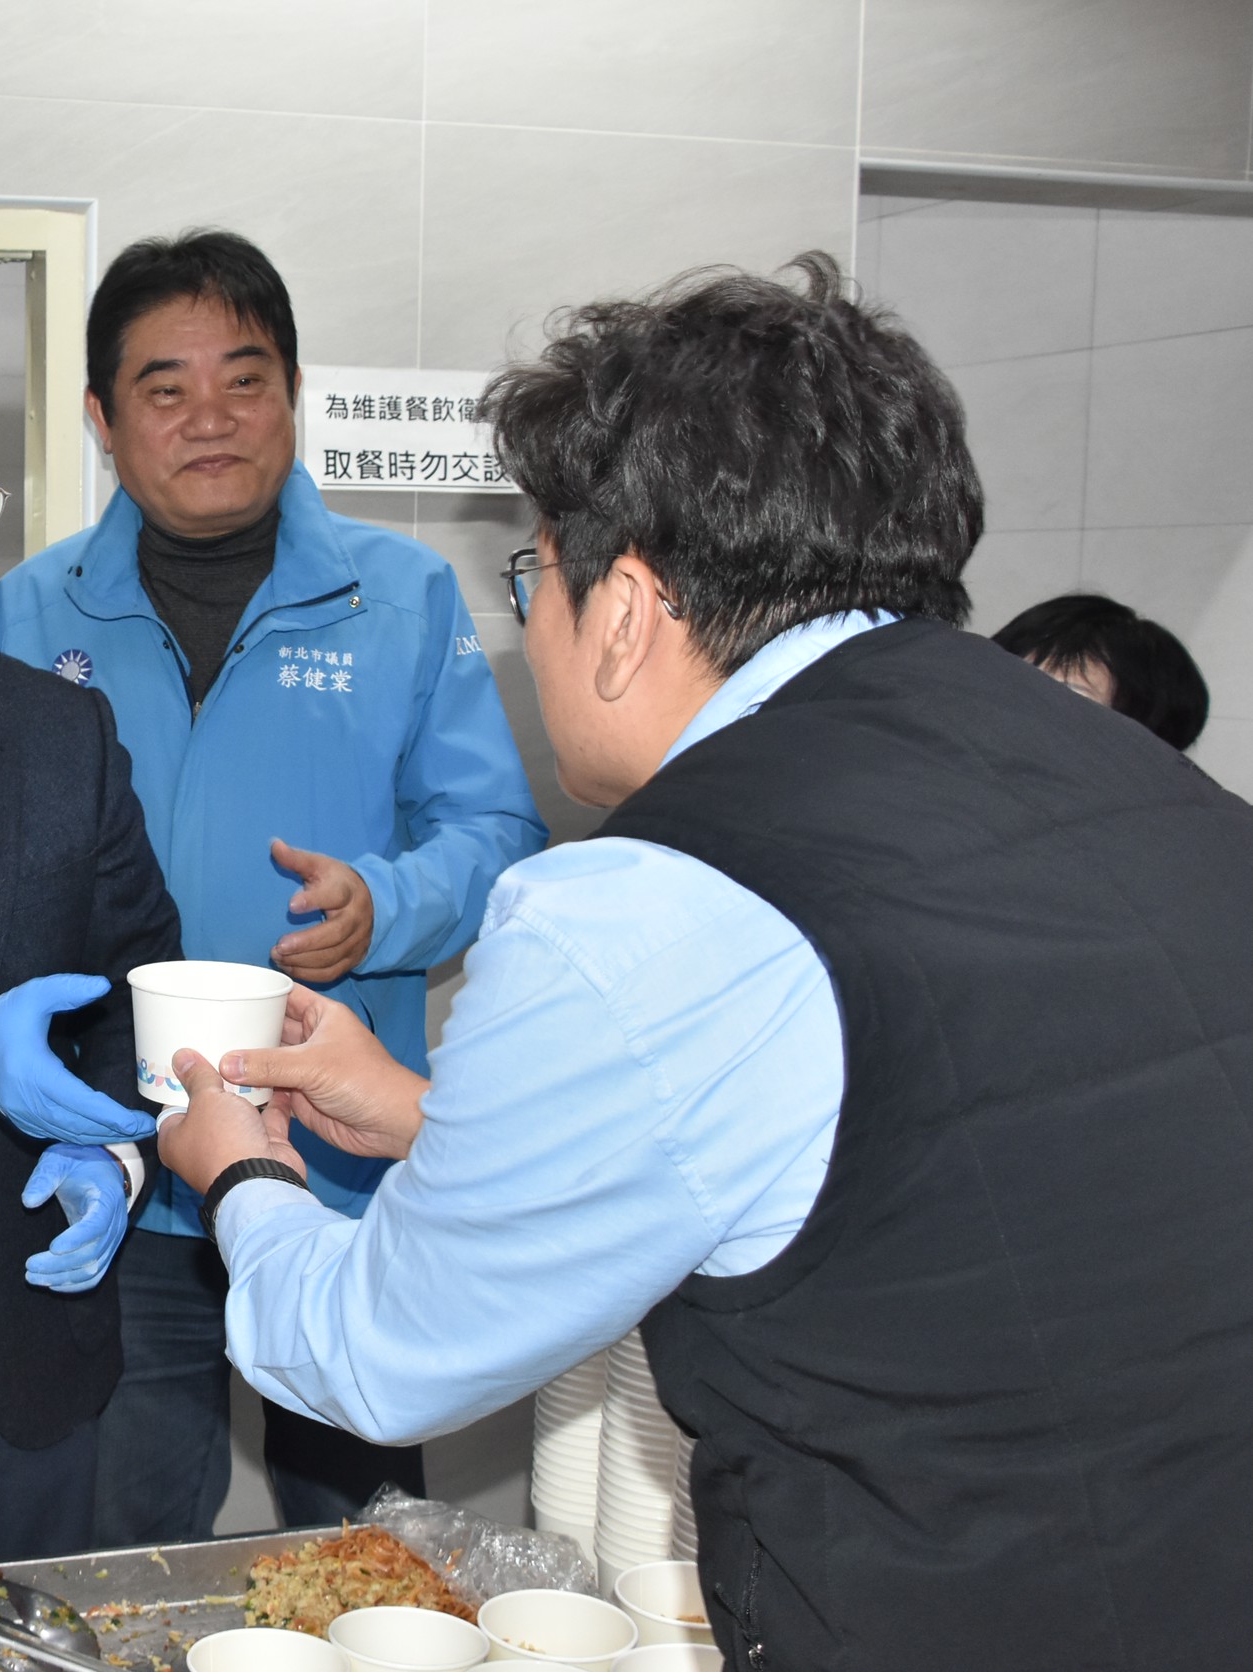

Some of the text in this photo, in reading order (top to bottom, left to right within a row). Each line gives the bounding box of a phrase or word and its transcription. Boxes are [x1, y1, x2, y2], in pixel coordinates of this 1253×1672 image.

[323, 449, 510, 483] 取餐時勿交談
[278, 645, 353, 667] 新北市議員
[277, 663, 353, 692] 蔡健棠
